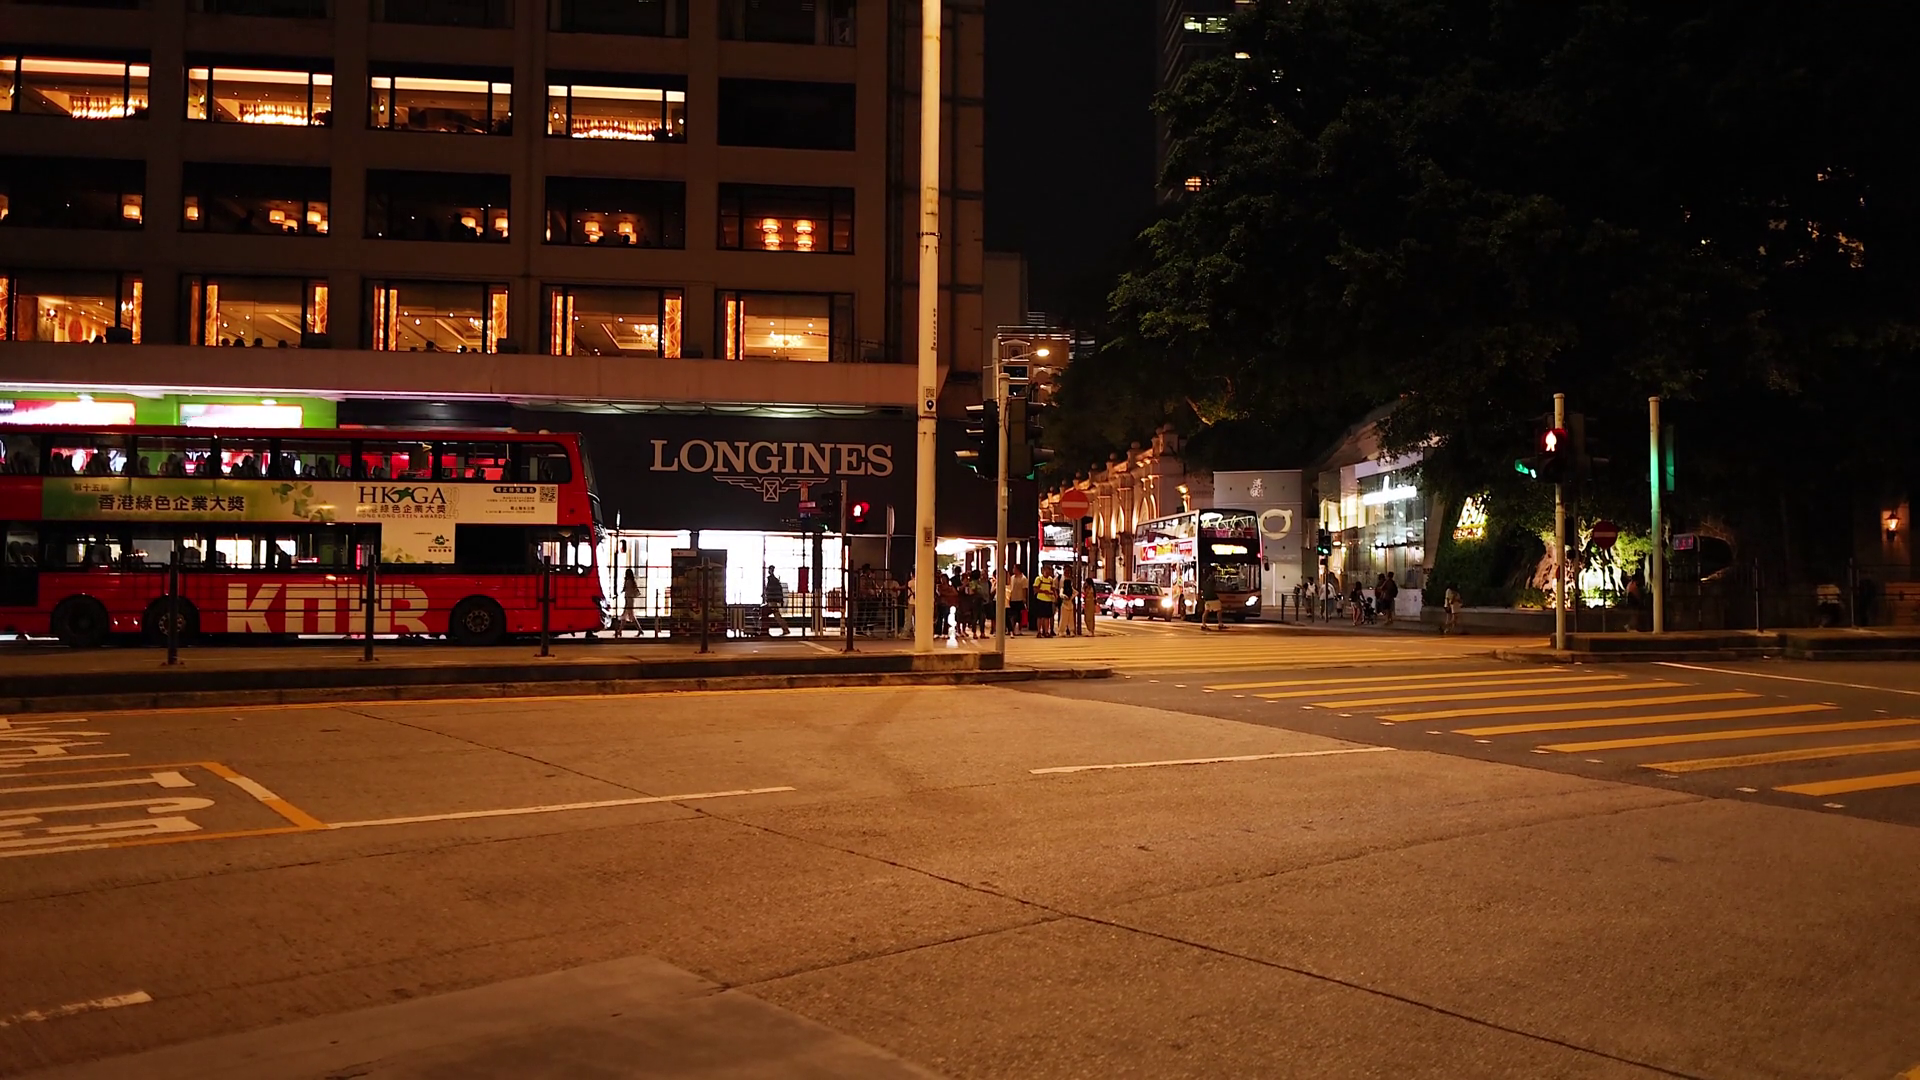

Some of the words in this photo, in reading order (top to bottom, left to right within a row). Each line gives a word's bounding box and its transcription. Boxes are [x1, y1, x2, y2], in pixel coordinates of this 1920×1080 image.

[650, 439, 894, 476] LONGINES
[98, 494, 245, 512] 香港綠色企業大獎
